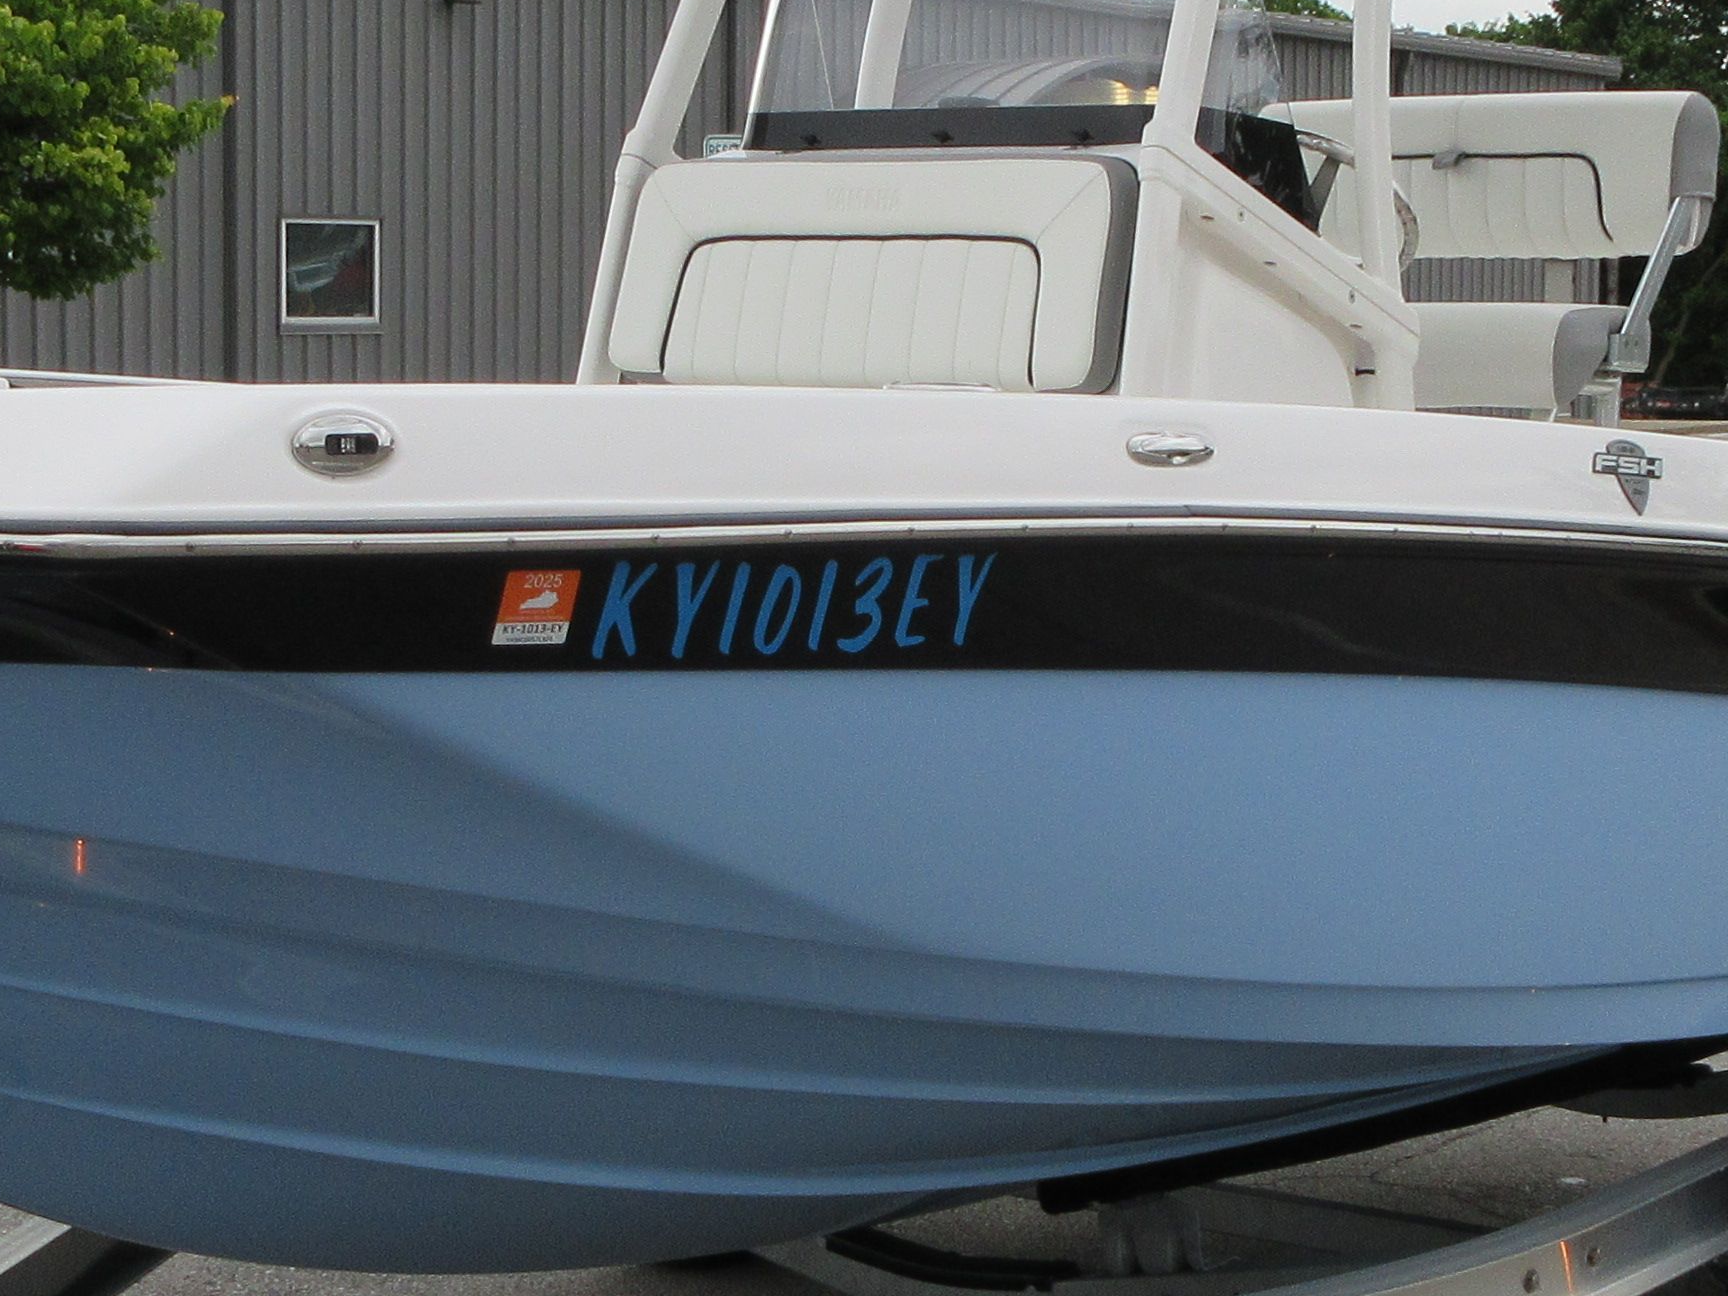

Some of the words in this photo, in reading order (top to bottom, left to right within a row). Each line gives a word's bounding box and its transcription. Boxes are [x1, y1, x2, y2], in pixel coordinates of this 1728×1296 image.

[1595, 454, 1663, 478] FSH
[523, 573, 564, 589] 2025
[591, 551, 998, 660] KY1013EY
[502, 623, 564, 634] KY-1013-EY
